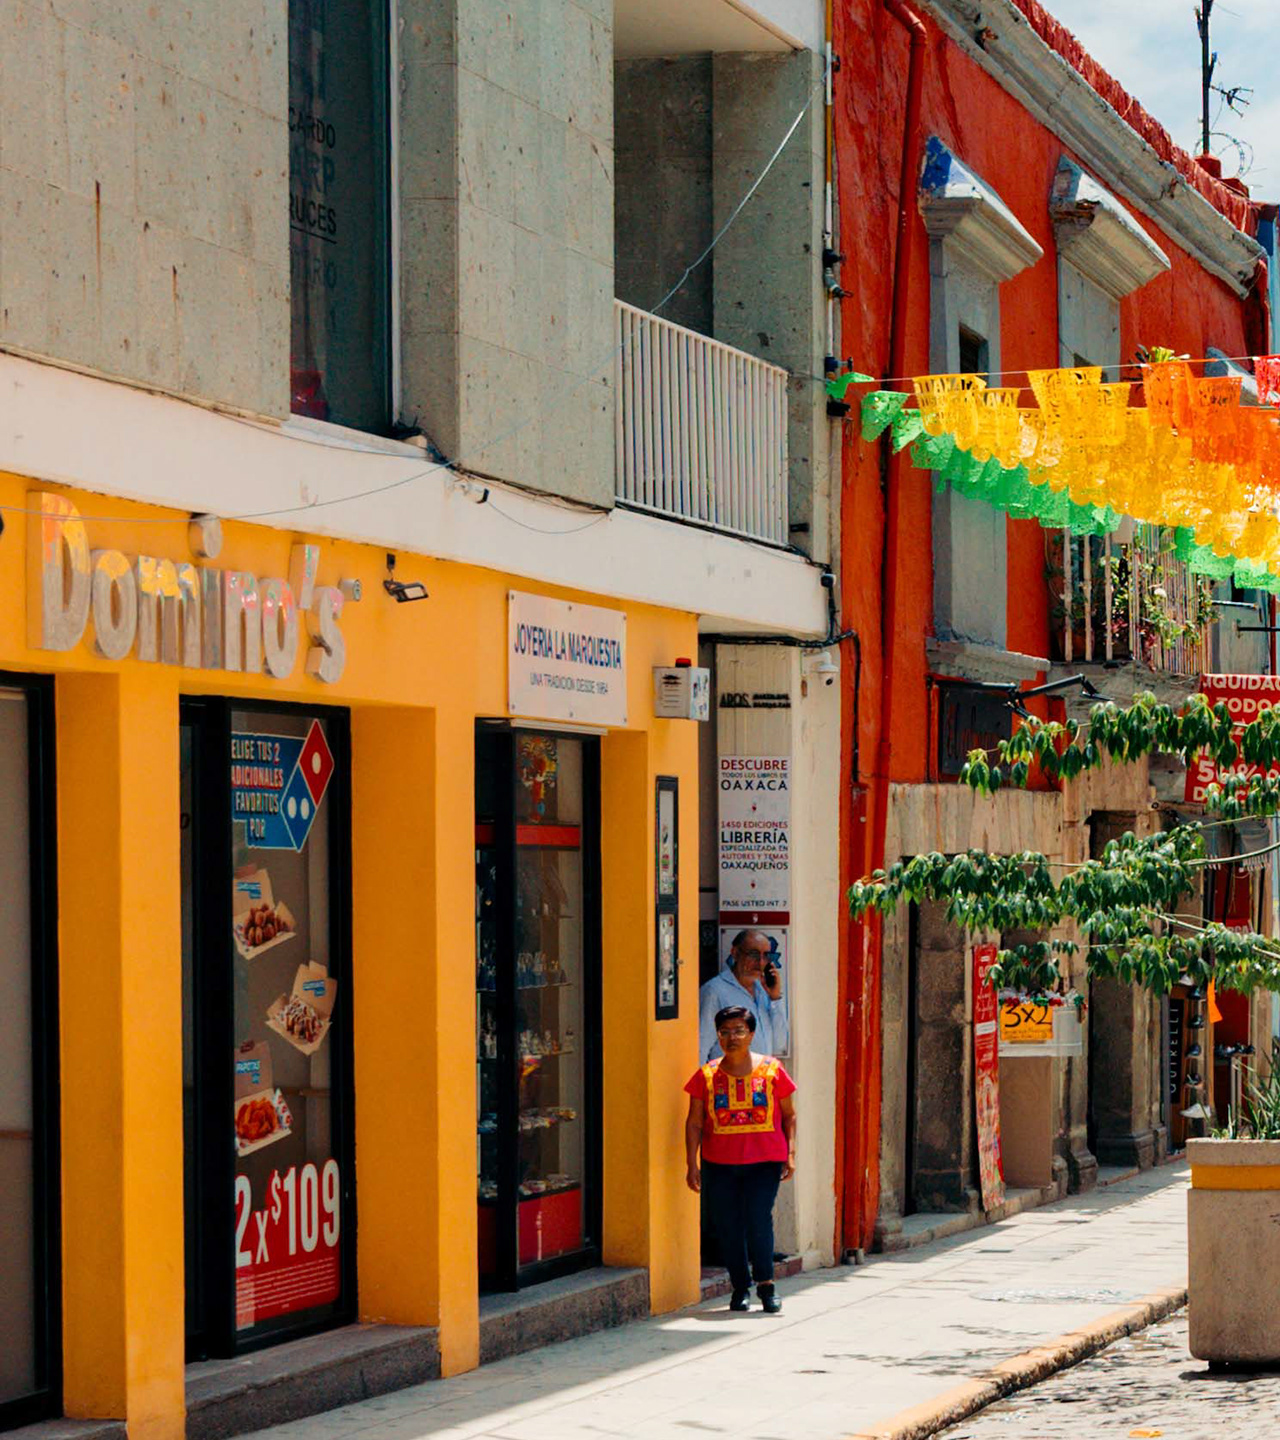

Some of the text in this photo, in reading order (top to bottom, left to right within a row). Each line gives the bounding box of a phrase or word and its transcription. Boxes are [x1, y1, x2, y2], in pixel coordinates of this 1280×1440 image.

[28, 491, 346, 683] Domino's
[514, 623, 554, 659] JOYERIA
[555, 630, 568, 660] LA
[1216, 697, 1272, 713] TODO
[231, 739, 280, 764] ELIGE TUS 2
[721, 759, 788, 770] DESCUBRE
[721, 779, 788, 791] OAXACA
[235, 791, 279, 813] FAVORITOS
[249, 819, 266, 838] POR
[721, 828, 788, 844] LIBRERÍA
